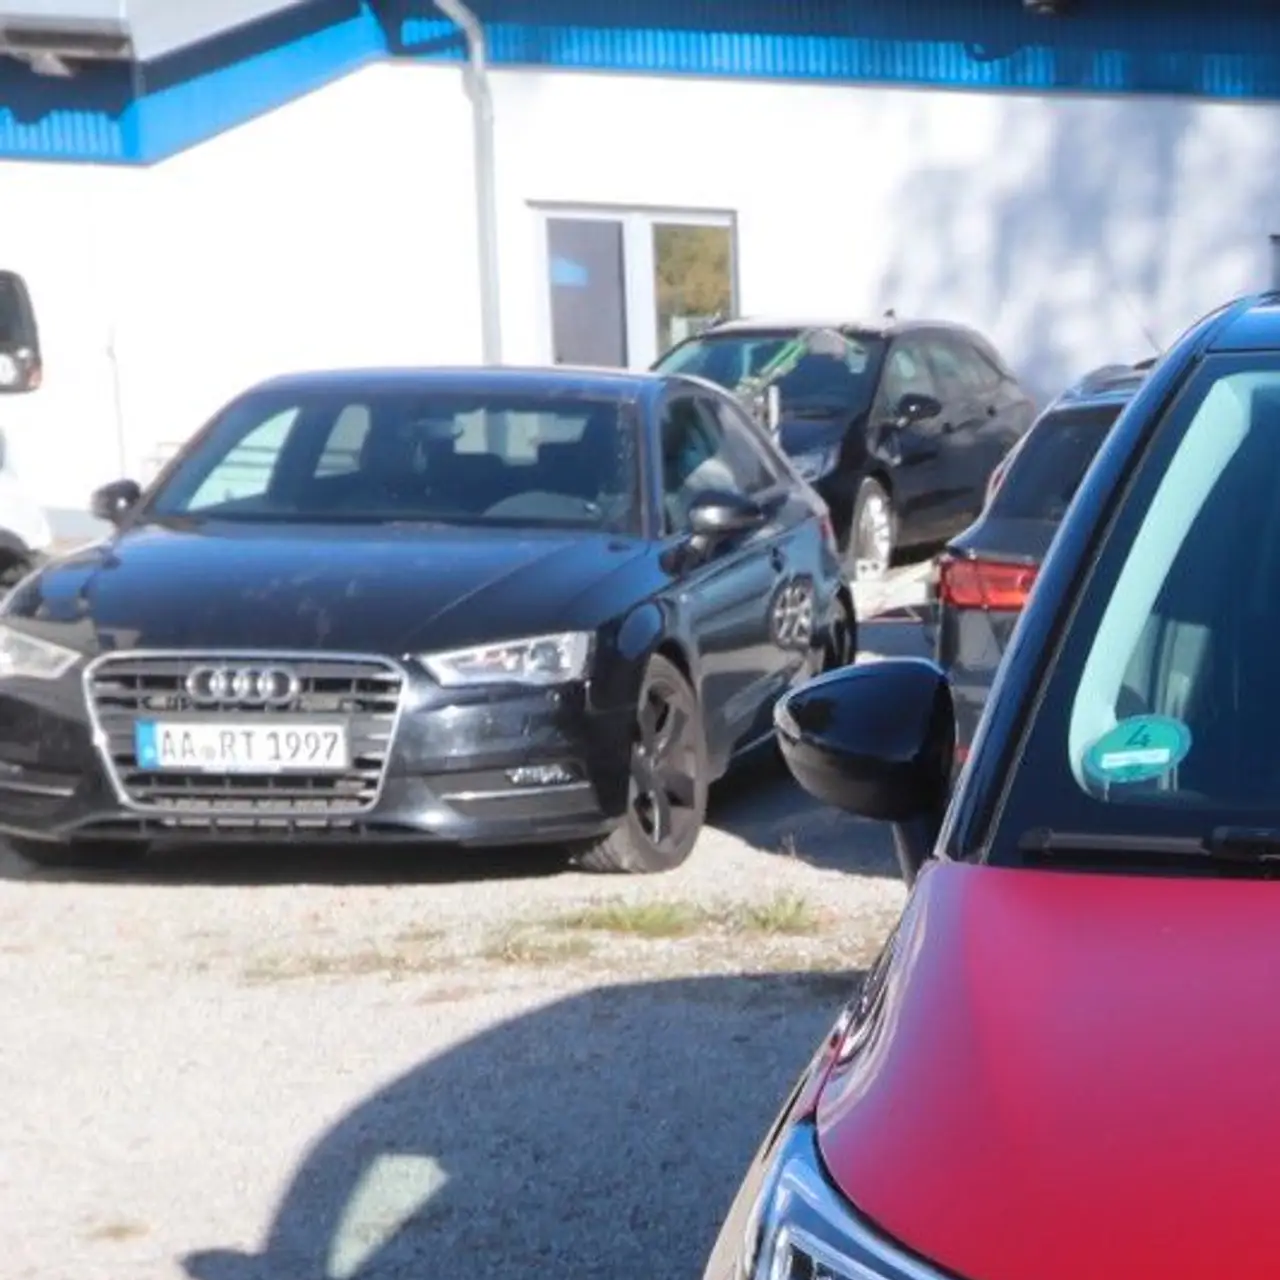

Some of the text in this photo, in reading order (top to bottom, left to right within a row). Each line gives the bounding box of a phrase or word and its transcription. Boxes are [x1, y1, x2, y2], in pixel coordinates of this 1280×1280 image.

[162, 729, 339, 762] AA RT 1997
[1123, 723, 1153, 748] 4
